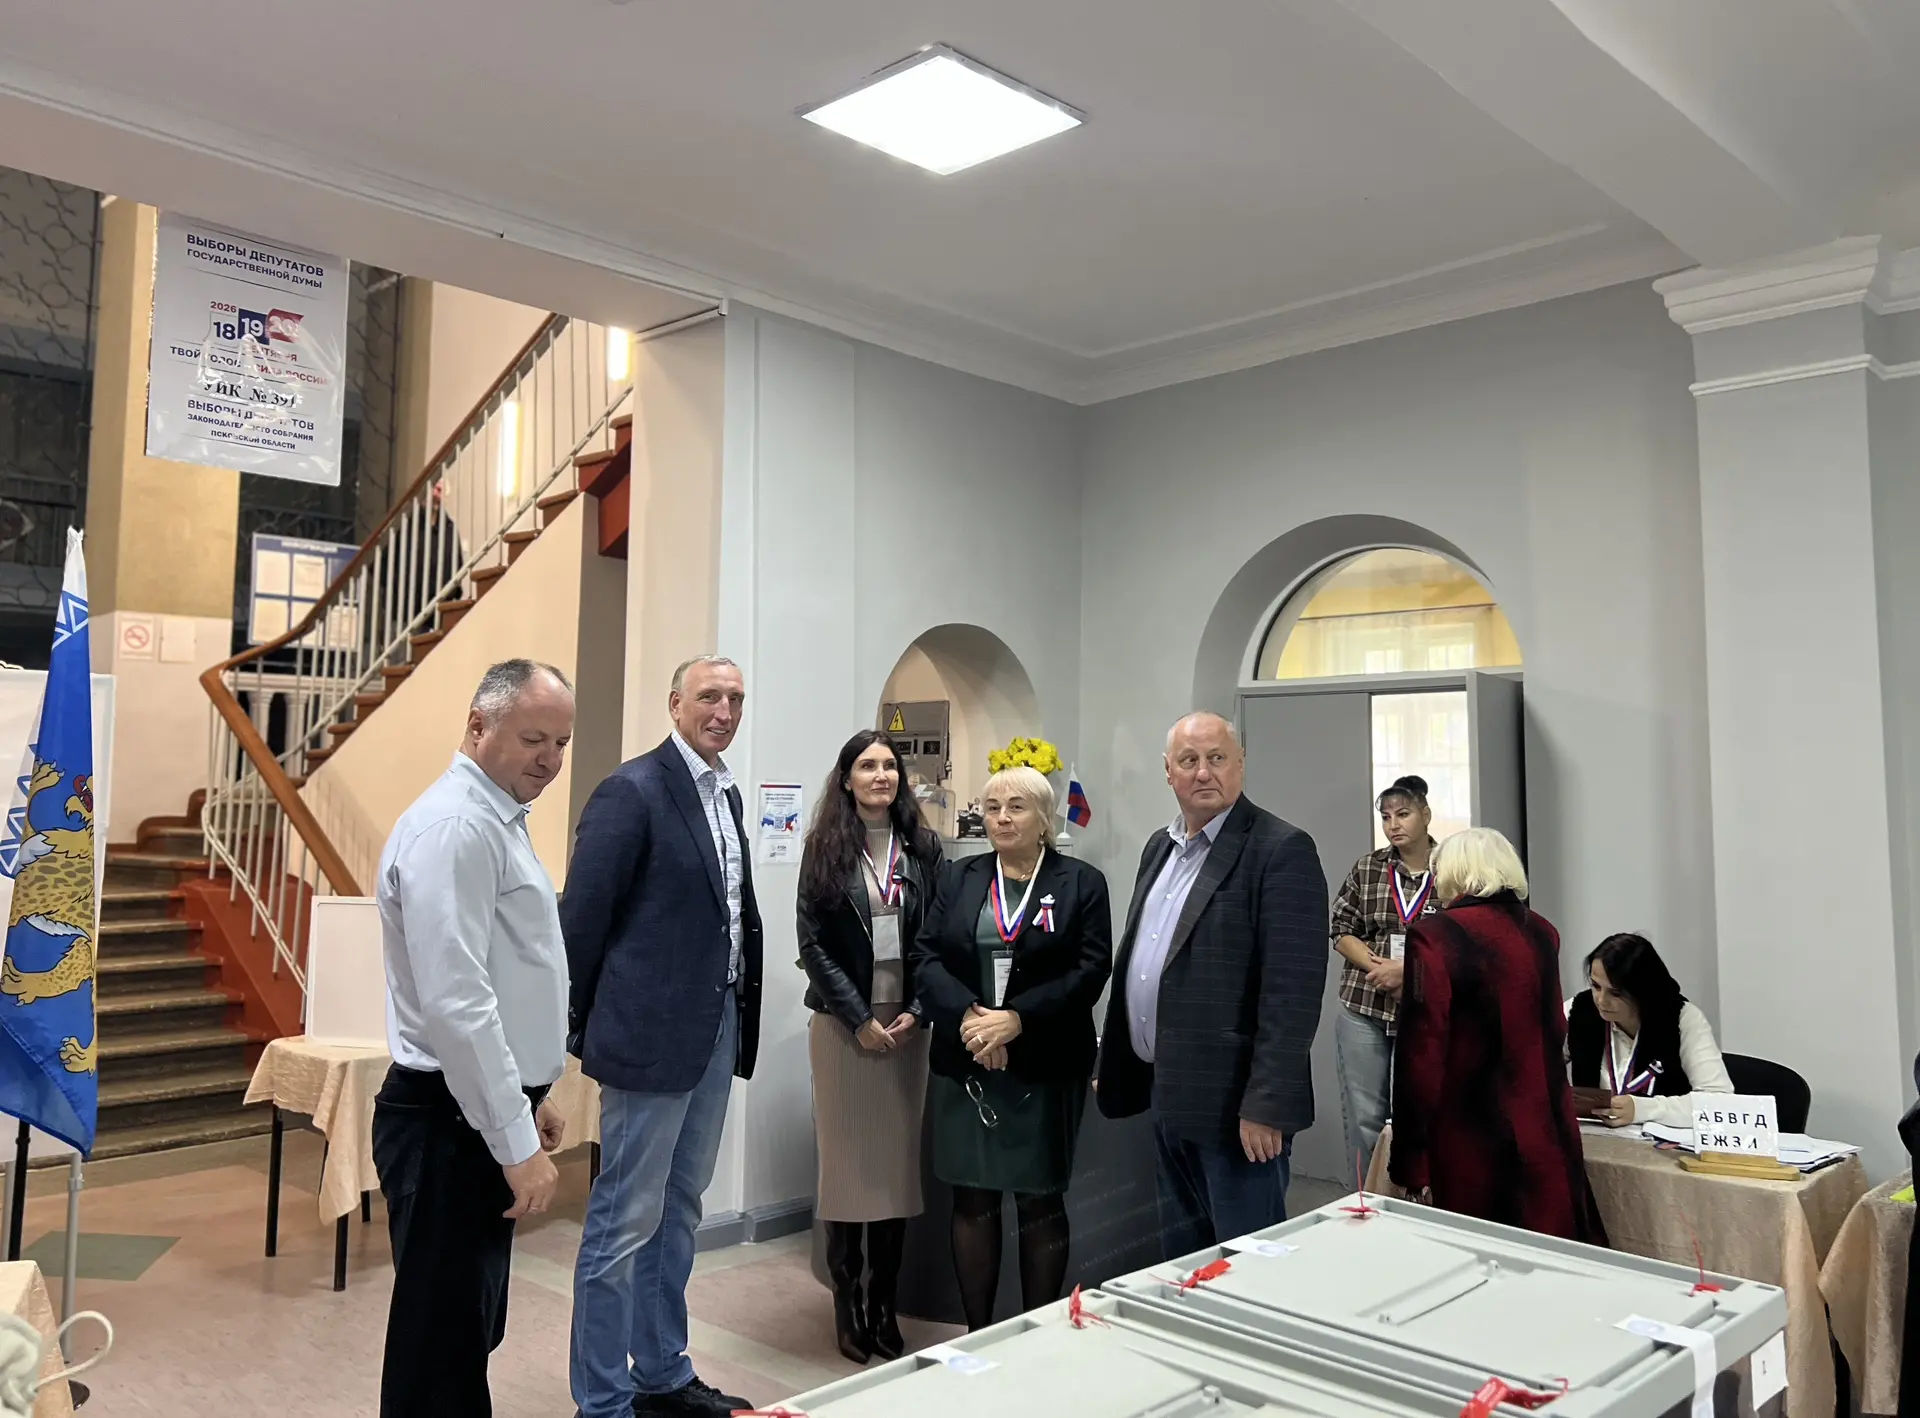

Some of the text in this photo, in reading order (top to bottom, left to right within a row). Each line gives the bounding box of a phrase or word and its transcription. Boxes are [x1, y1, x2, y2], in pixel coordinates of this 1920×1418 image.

[187, 234, 324, 277] ВЫБОРЫ ДЕПУТАТОВ
[187, 248, 322, 289] ГОСУДАРСТВЕННОЙ ДУМЫ
[210, 301, 237, 313] 2026
[213, 322, 236, 340] 18
[241, 317, 264, 337] 19
[170, 346, 201, 359] ТВОЙ
[272, 428, 314, 442] СОБРАНИЯ
[261, 438, 296, 450] ОБЛАСТИ
